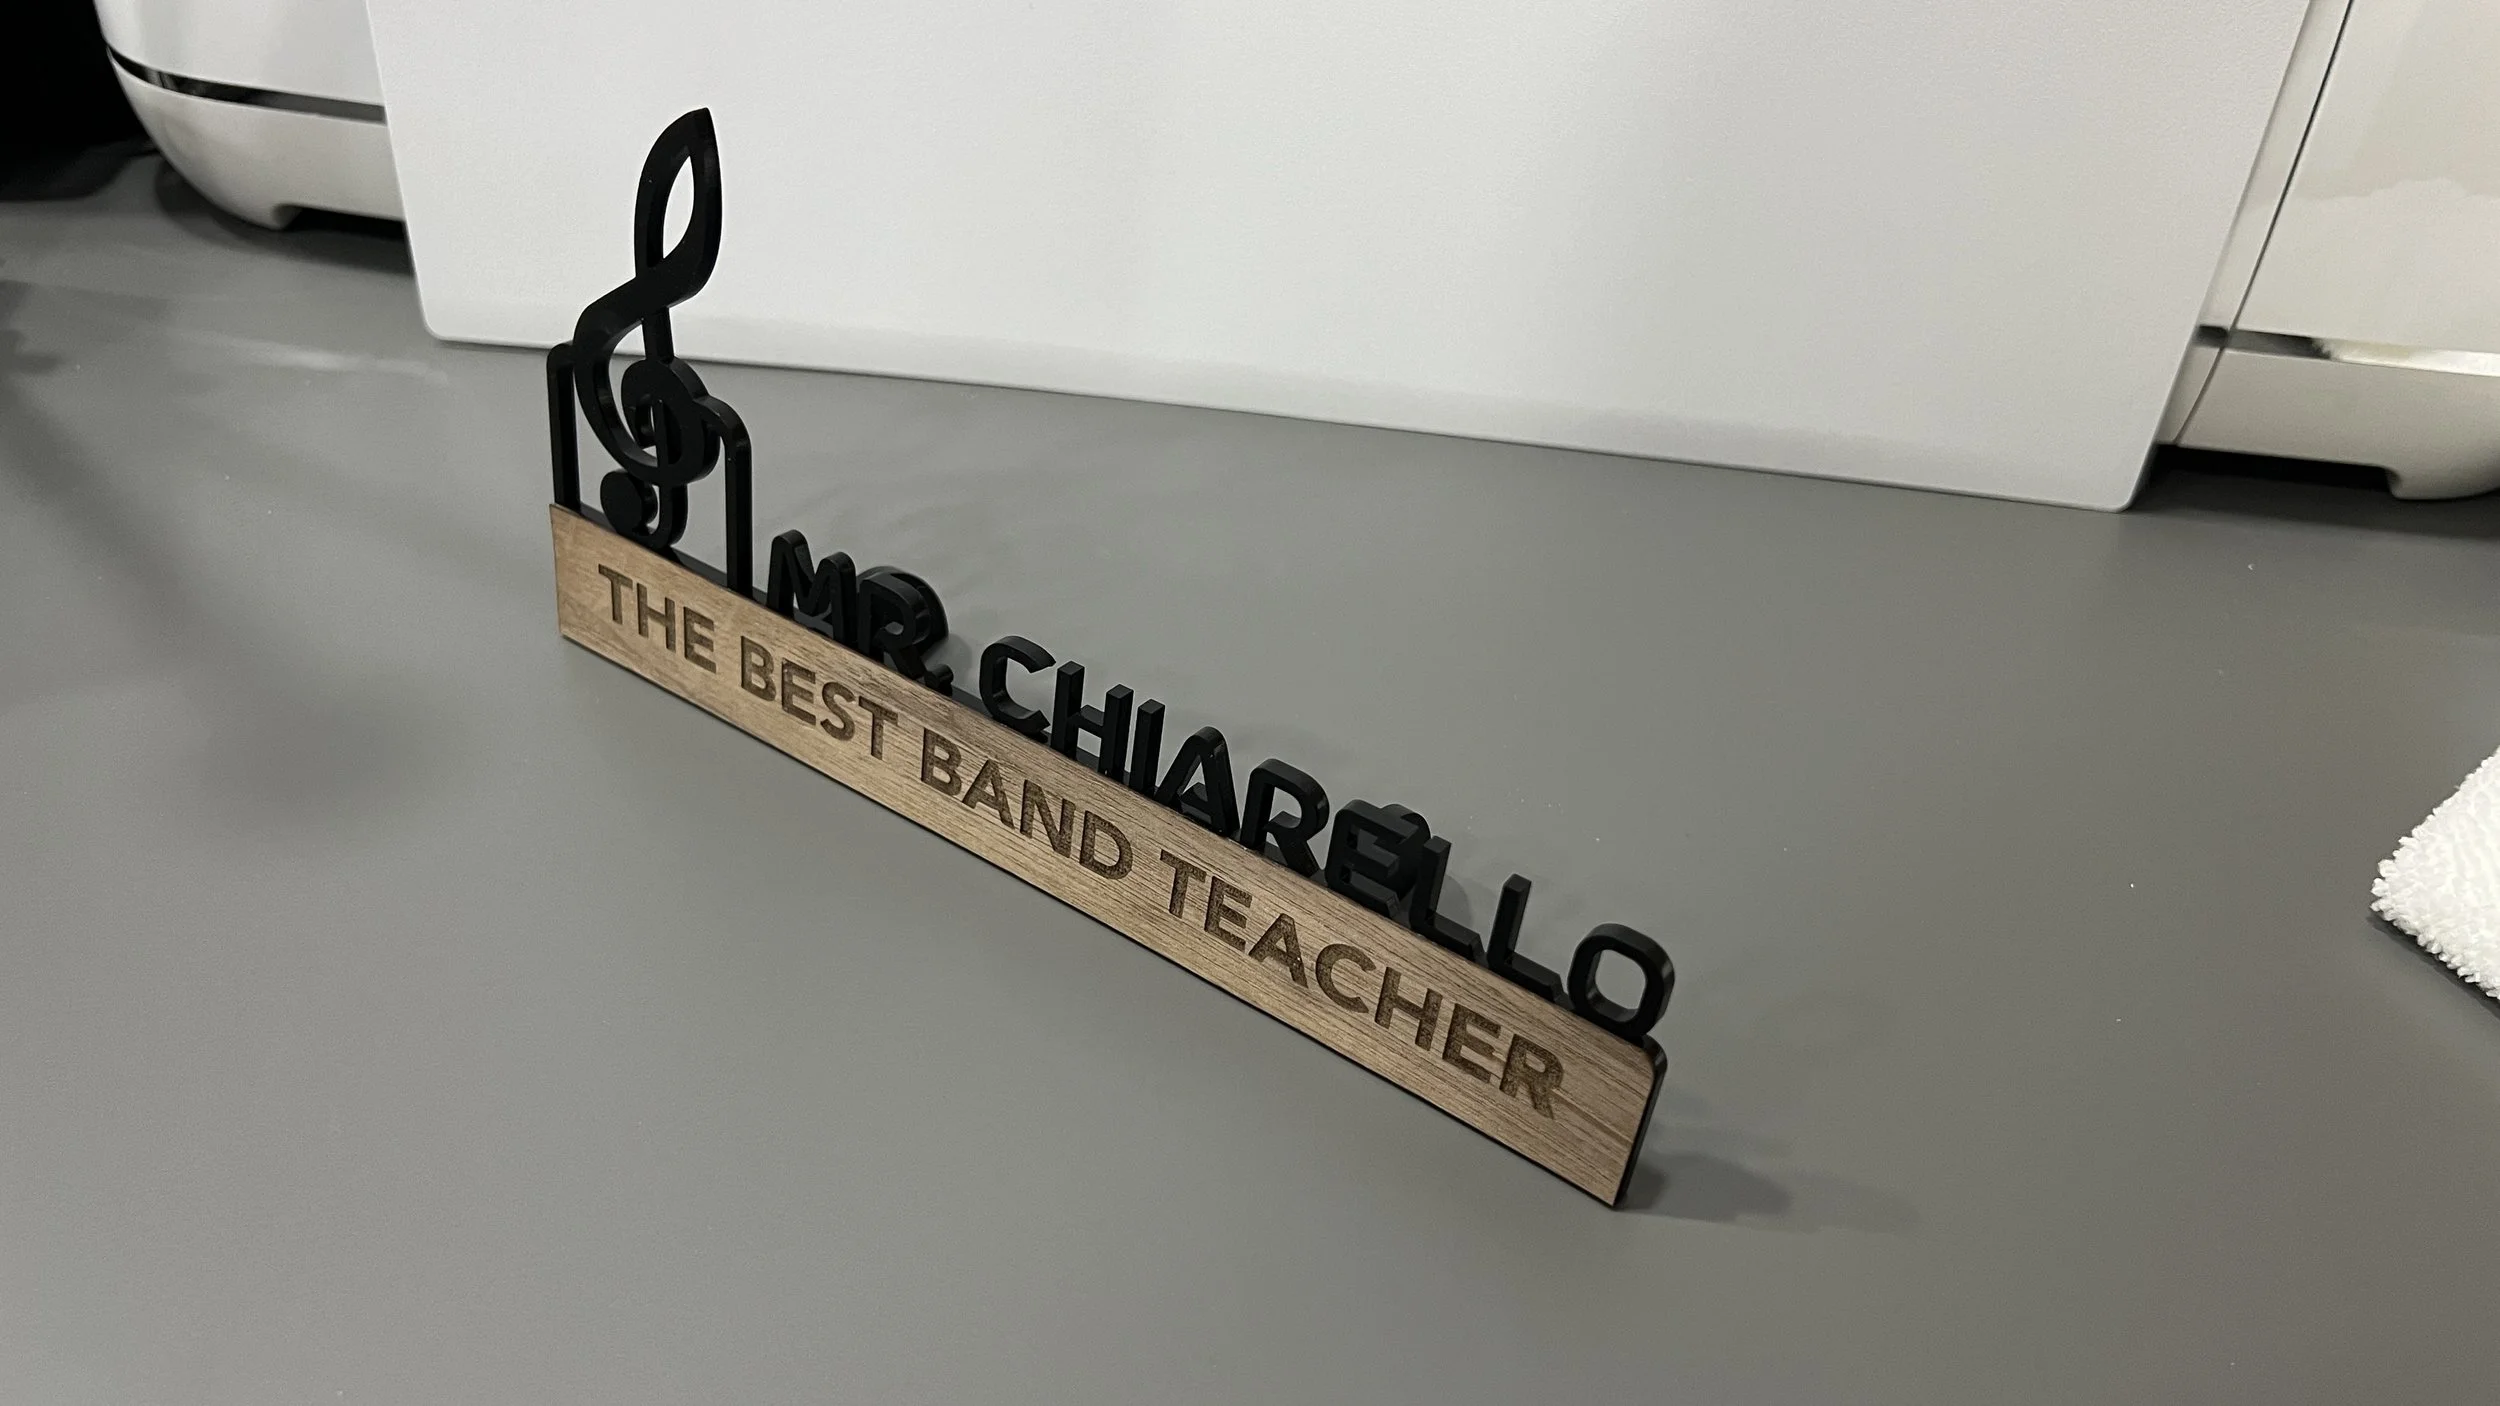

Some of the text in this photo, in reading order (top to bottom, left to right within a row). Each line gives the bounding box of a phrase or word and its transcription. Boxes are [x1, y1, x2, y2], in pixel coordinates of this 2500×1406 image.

[598, 563, 1566, 1119] THE BEST BAND TEACHER
[766, 529, 1676, 1039] MR. CHIARELLO
